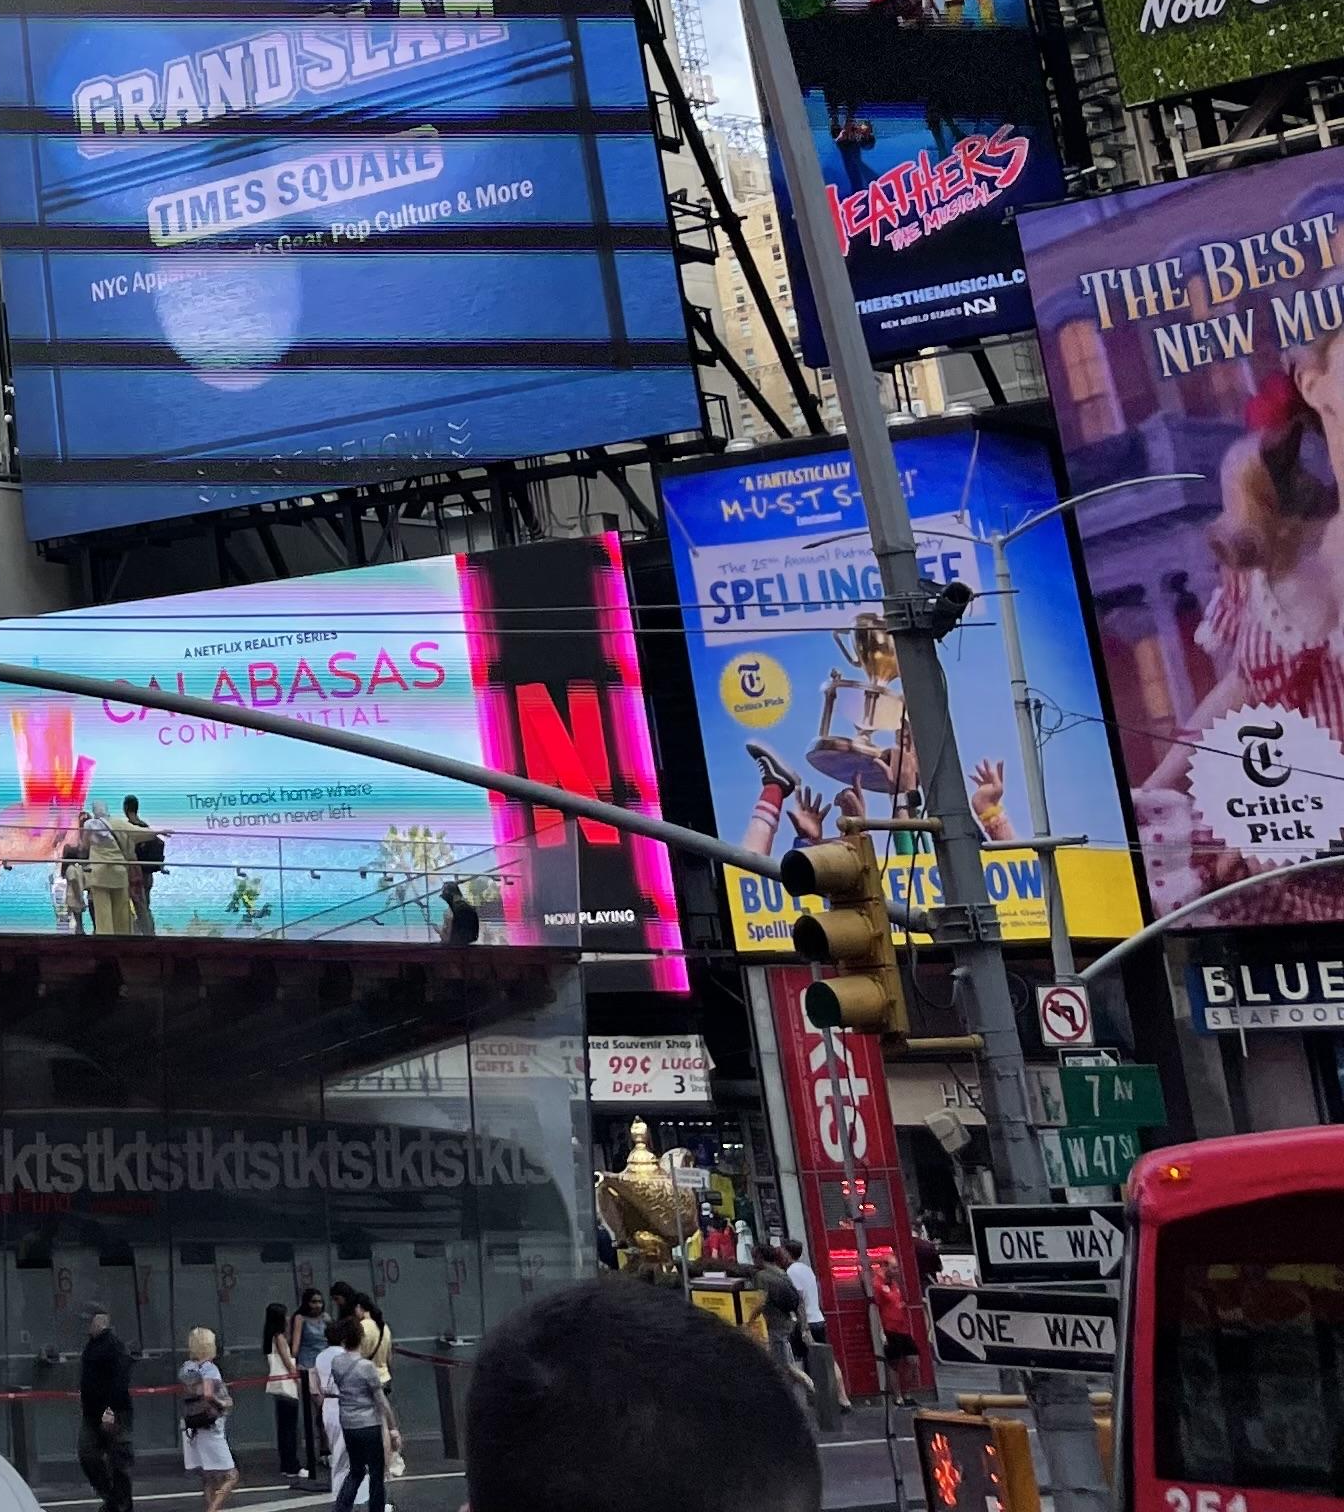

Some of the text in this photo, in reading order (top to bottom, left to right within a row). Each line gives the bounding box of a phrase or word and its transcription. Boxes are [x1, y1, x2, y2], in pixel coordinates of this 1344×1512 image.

[73, 28, 300, 158] GRAND
[154, 140, 436, 239] TIMES SQUARE
[331, 178, 534, 245] Pop Culture & More
[924, 181, 1004, 236] MUSICAL
[1079, 211, 1337, 329] THE BEST
[91, 274, 128, 302] NYC
[1154, 308, 1256, 378] NEW
[755, 461, 853, 491] FANTASTICALLY
[718, 561, 747, 576] The
[709, 564, 886, 626] SPELLING
[184, 630, 339, 660] A NETFLIX REALITY SERIES
[239, 786, 275, 807] back
[279, 784, 324, 804] home
[326, 780, 373, 798] where
[1226, 793, 1324, 819] Critic's
[206, 812, 230, 830] the
[232, 809, 282, 829] drama
[284, 807, 325, 823] never
[1246, 819, 1316, 844] Pick
[544, 910, 635, 926] NOW PLAYING
[1202, 960, 1344, 1003] BLUE
[613, 1039, 691, 1050] Souvenir Shop
[613, 1081, 653, 1096] Dept.
[673, 1074, 686, 1094] 3
[1084, 1075, 1101, 1117] 7
[1067, 1137, 1090, 1178] W
[1093, 1136, 1118, 1177] 47
[999, 1228, 1115, 1261] ONE WAY
[957, 1311, 1106, 1349] ONE WAY
